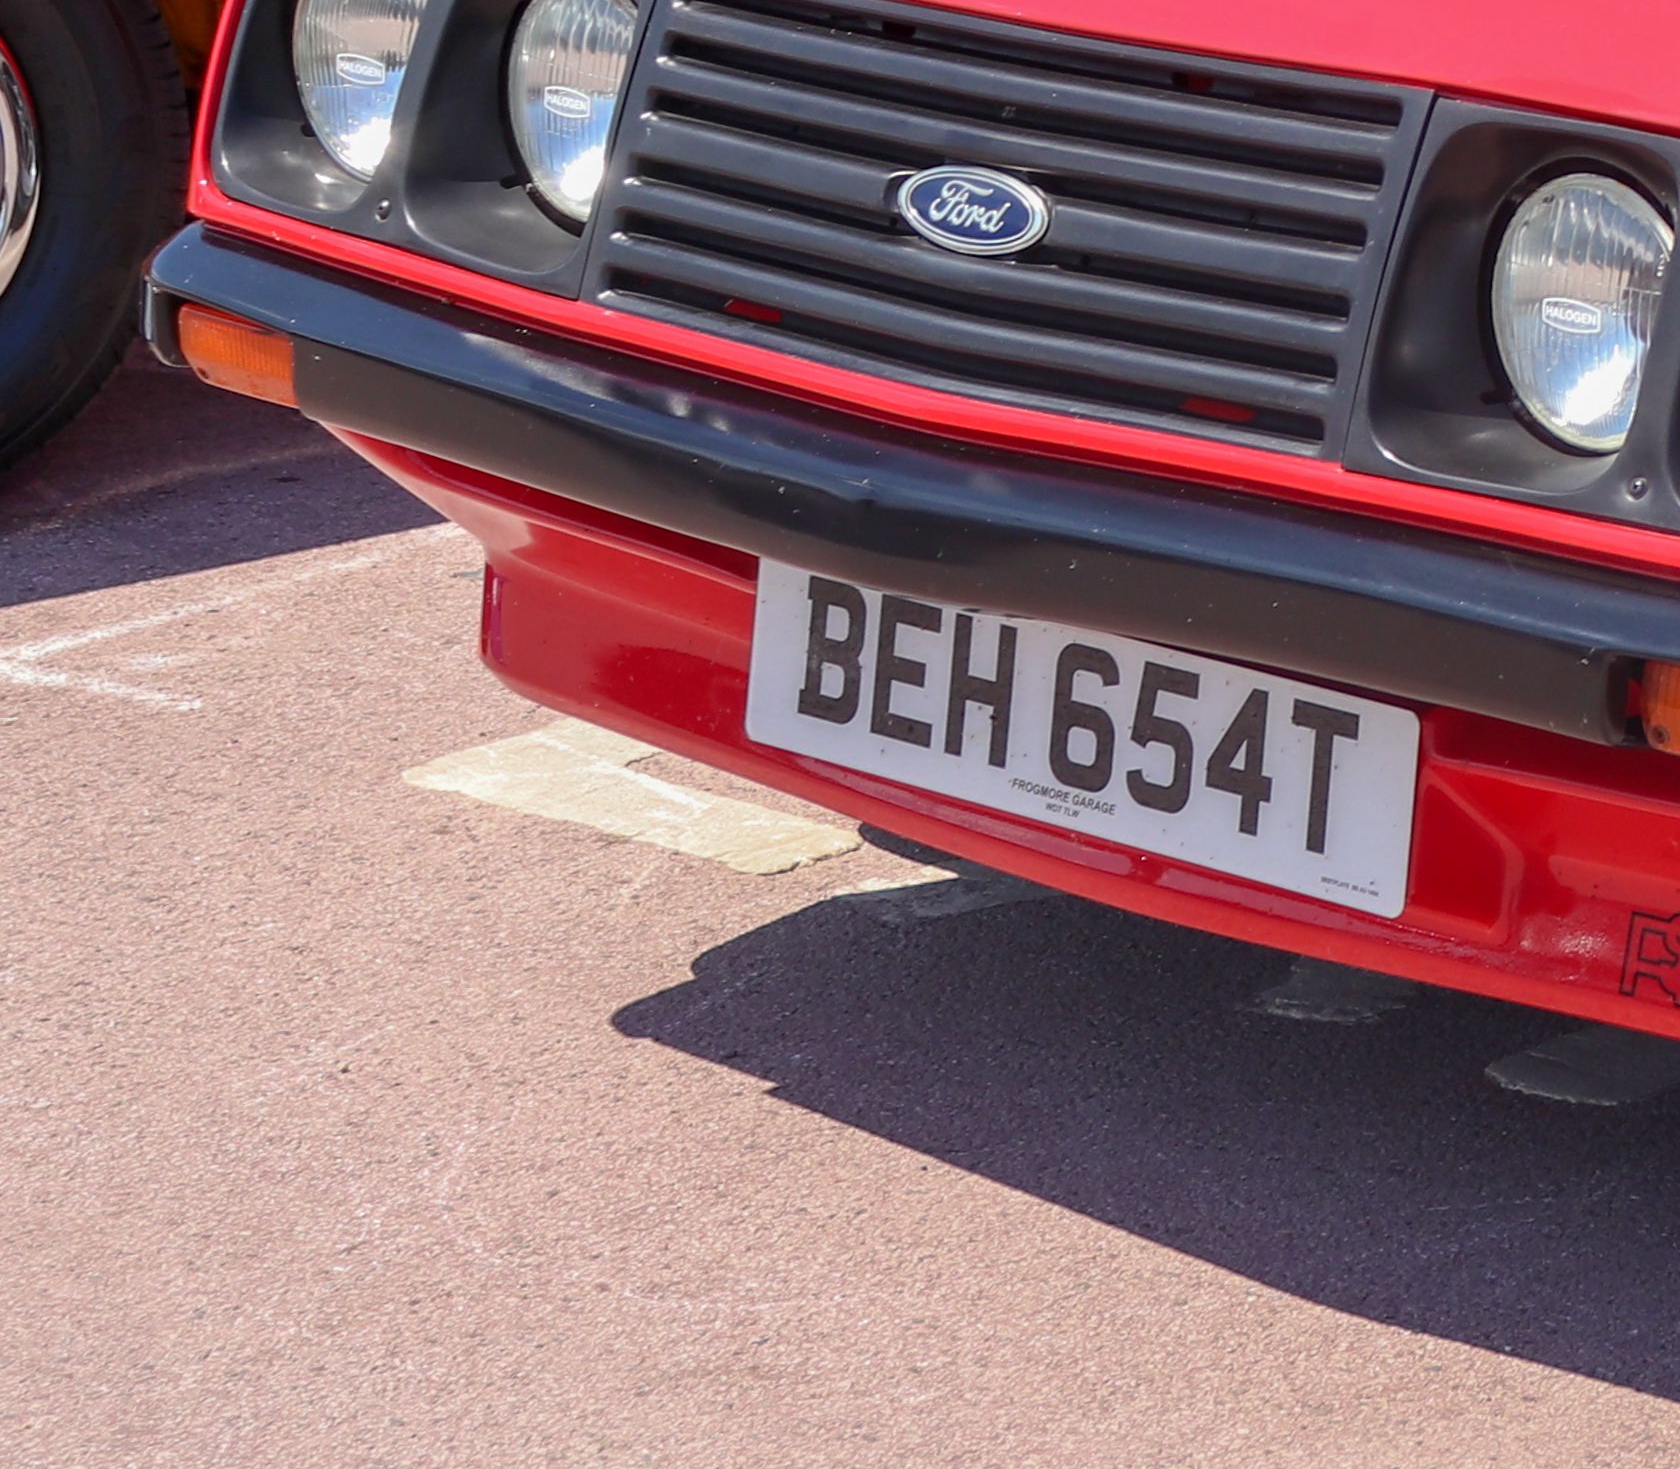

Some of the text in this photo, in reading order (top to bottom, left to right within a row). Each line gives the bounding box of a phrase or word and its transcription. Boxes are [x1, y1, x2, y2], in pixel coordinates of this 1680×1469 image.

[338, 57, 384, 82] HALOGEN
[546, 92, 590, 115] HALOGEN
[929, 180, 1012, 234] Ford
[1544, 304, 1598, 328] HALOGEN
[797, 576, 1362, 855] BEH 654T
[1011, 778, 1118, 816] FROGMORE GARAGE
